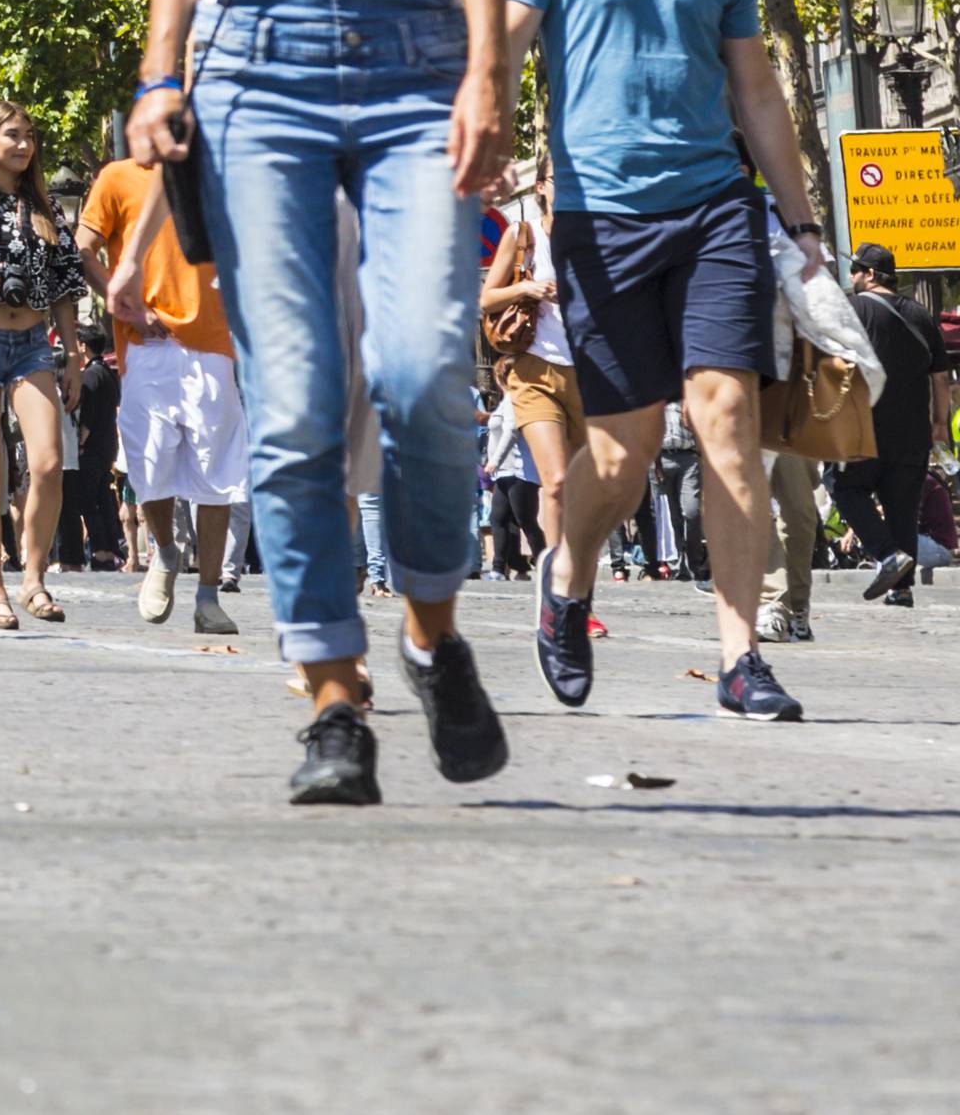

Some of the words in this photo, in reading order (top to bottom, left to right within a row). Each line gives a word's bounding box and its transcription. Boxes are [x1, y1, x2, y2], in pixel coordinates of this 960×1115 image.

[850, 147, 897, 157] TRAVAUX
[854, 218, 914, 229] ITINÉRAIRE
[905, 241, 956, 251] WAGRAM
